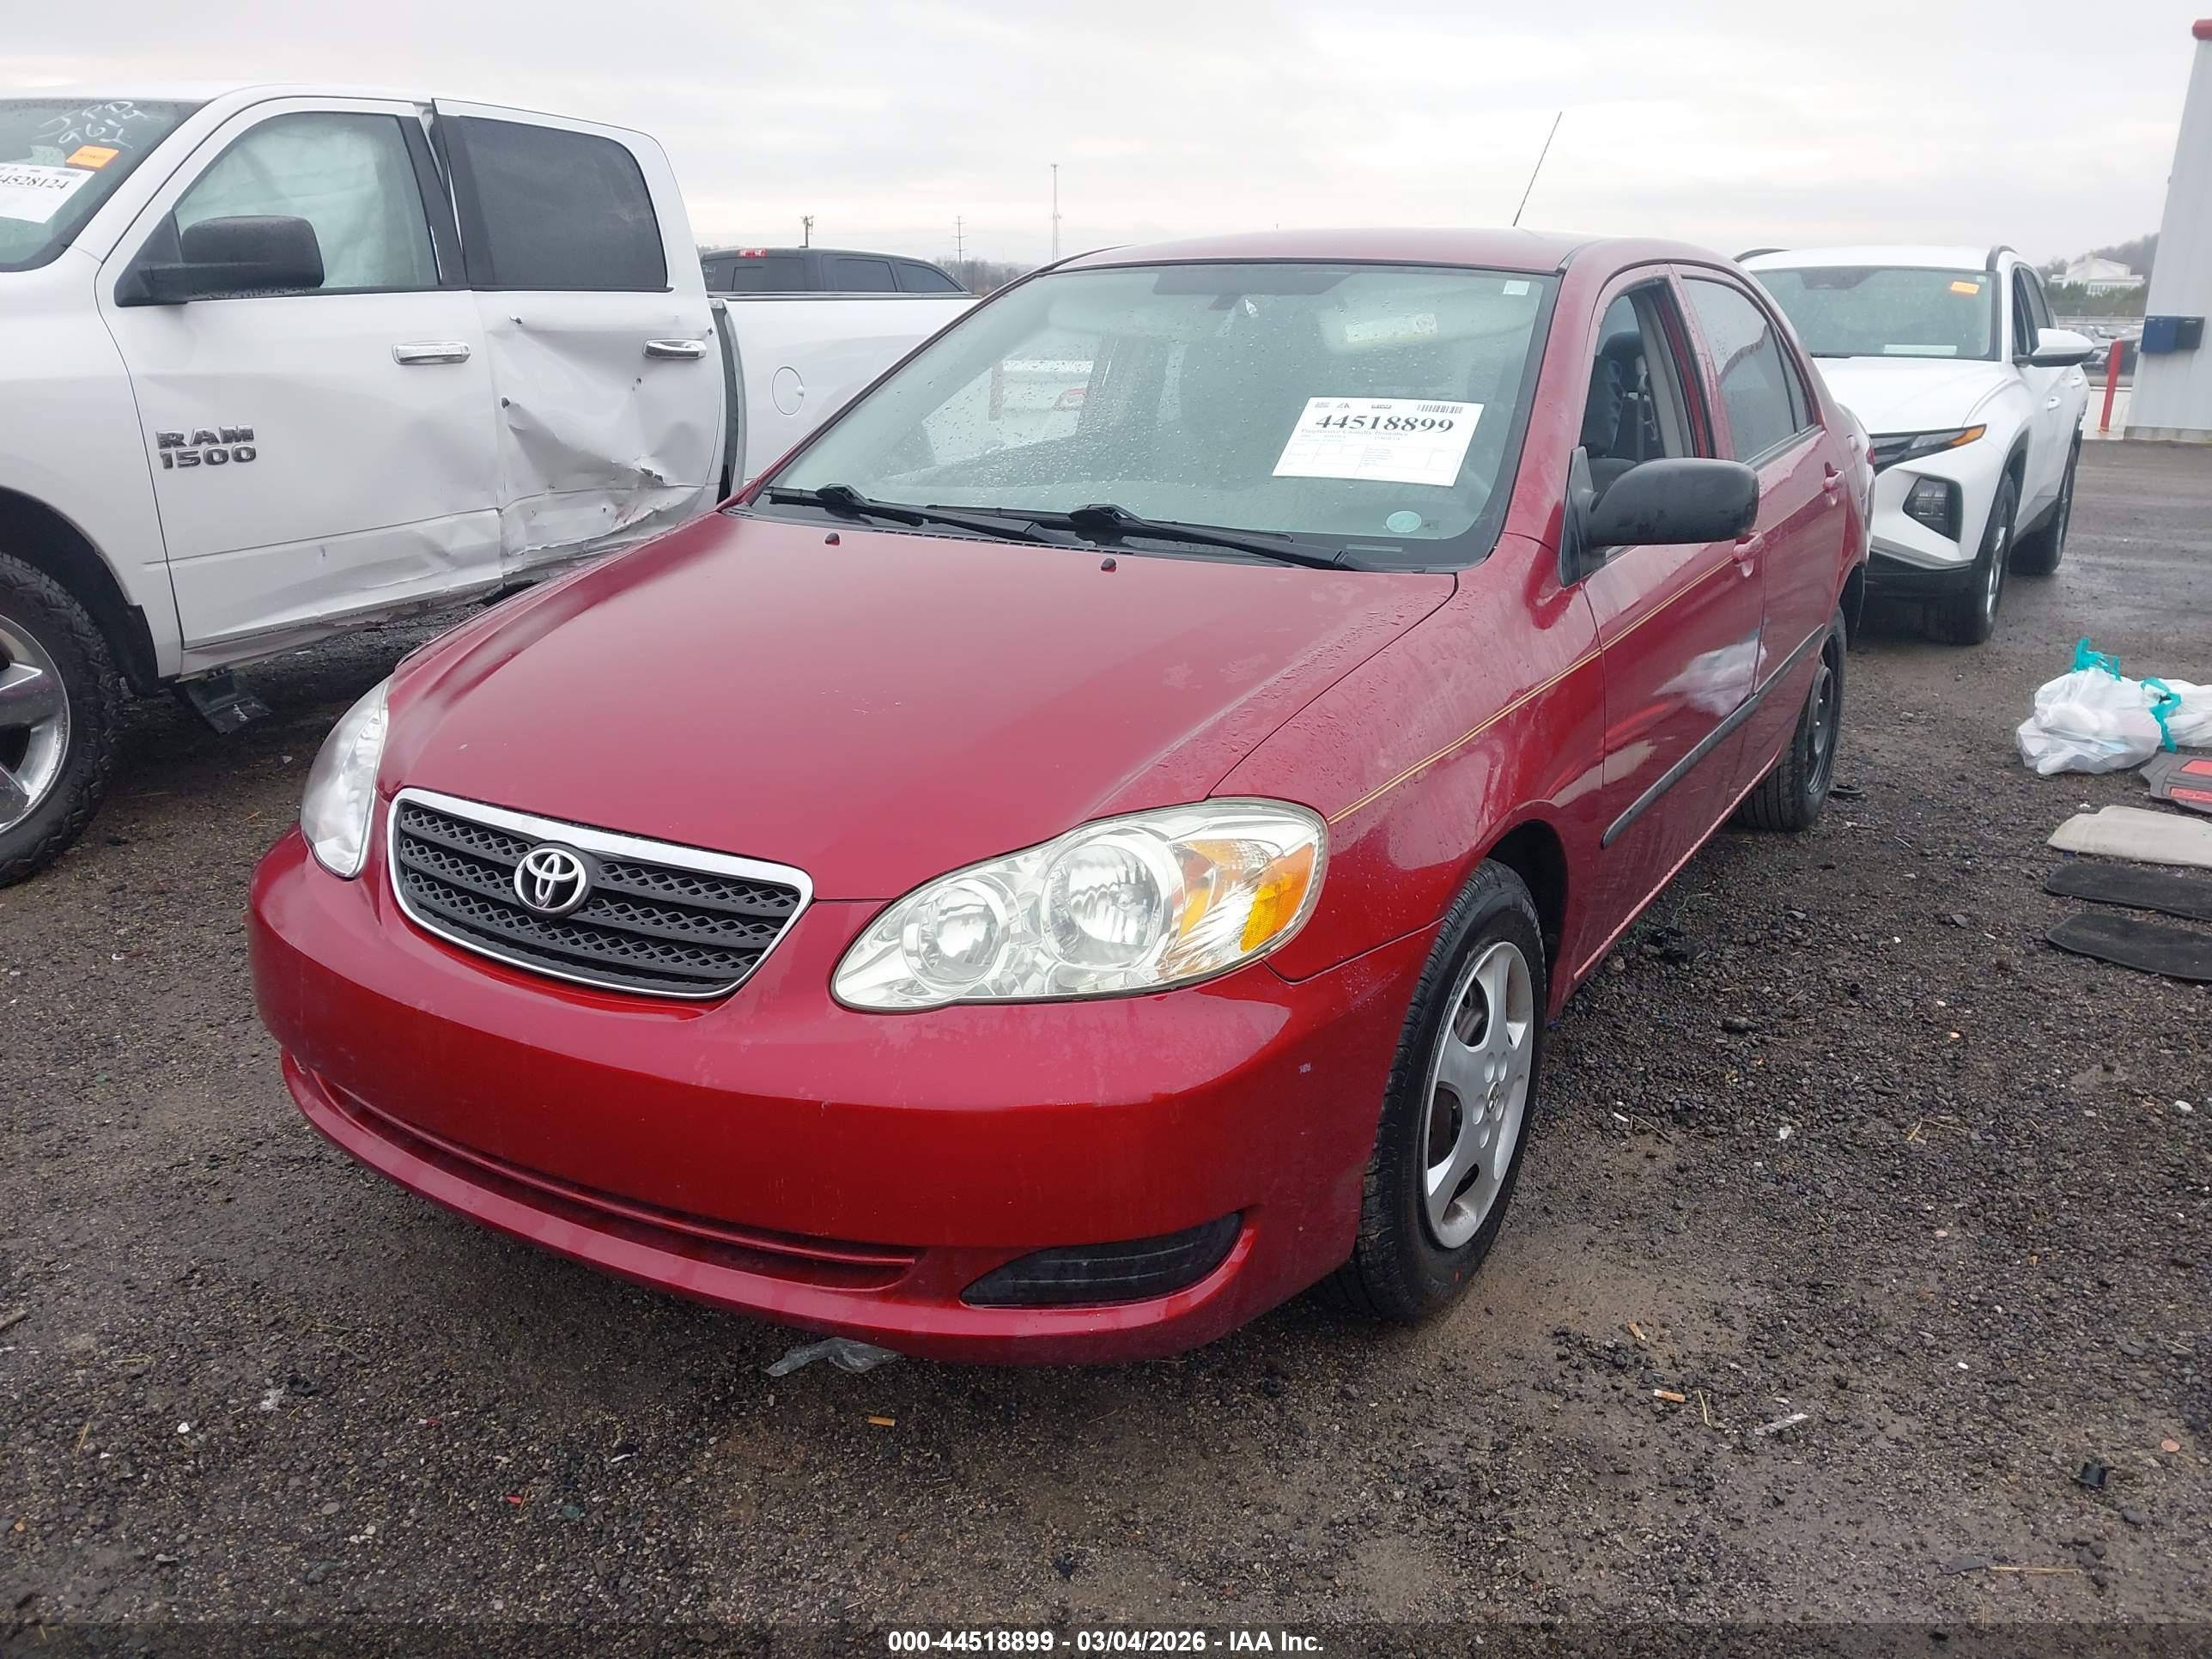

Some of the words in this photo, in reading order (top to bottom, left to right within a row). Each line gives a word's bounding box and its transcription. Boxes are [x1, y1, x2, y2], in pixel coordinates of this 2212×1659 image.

[0, 174, 70, 189] 4528124
[1315, 414, 1455, 434] 44518899
[155, 424, 255, 449] RAM
[159, 444, 257, 470] 1500
